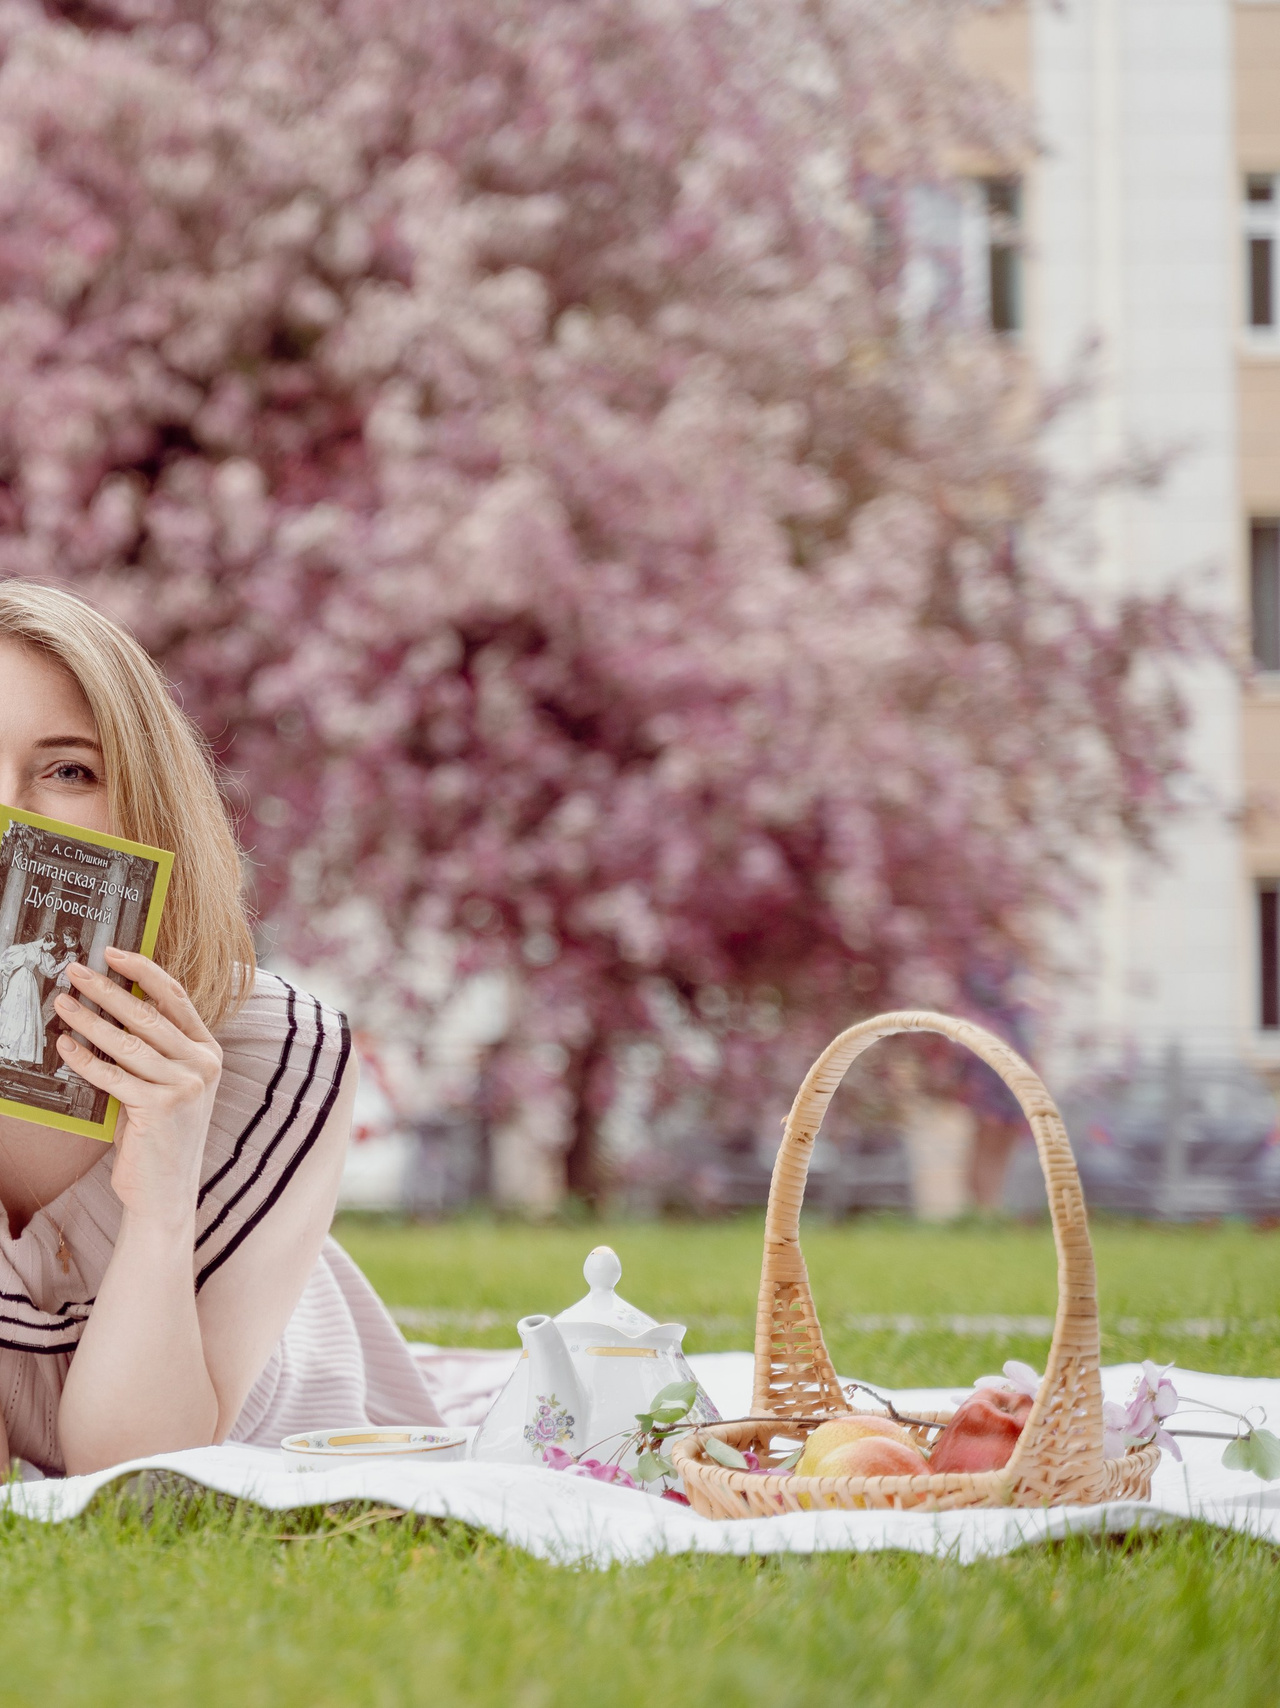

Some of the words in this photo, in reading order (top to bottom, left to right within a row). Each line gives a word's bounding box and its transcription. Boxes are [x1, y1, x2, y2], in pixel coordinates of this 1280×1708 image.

[51, 843, 62, 855] А.
[63, 846, 73, 858] С.
[74, 849, 109, 869] Пушкин
[10, 850, 96, 890] Капитанская
[97, 880, 140, 903] дочка
[24, 885, 113, 924] Дубровский
